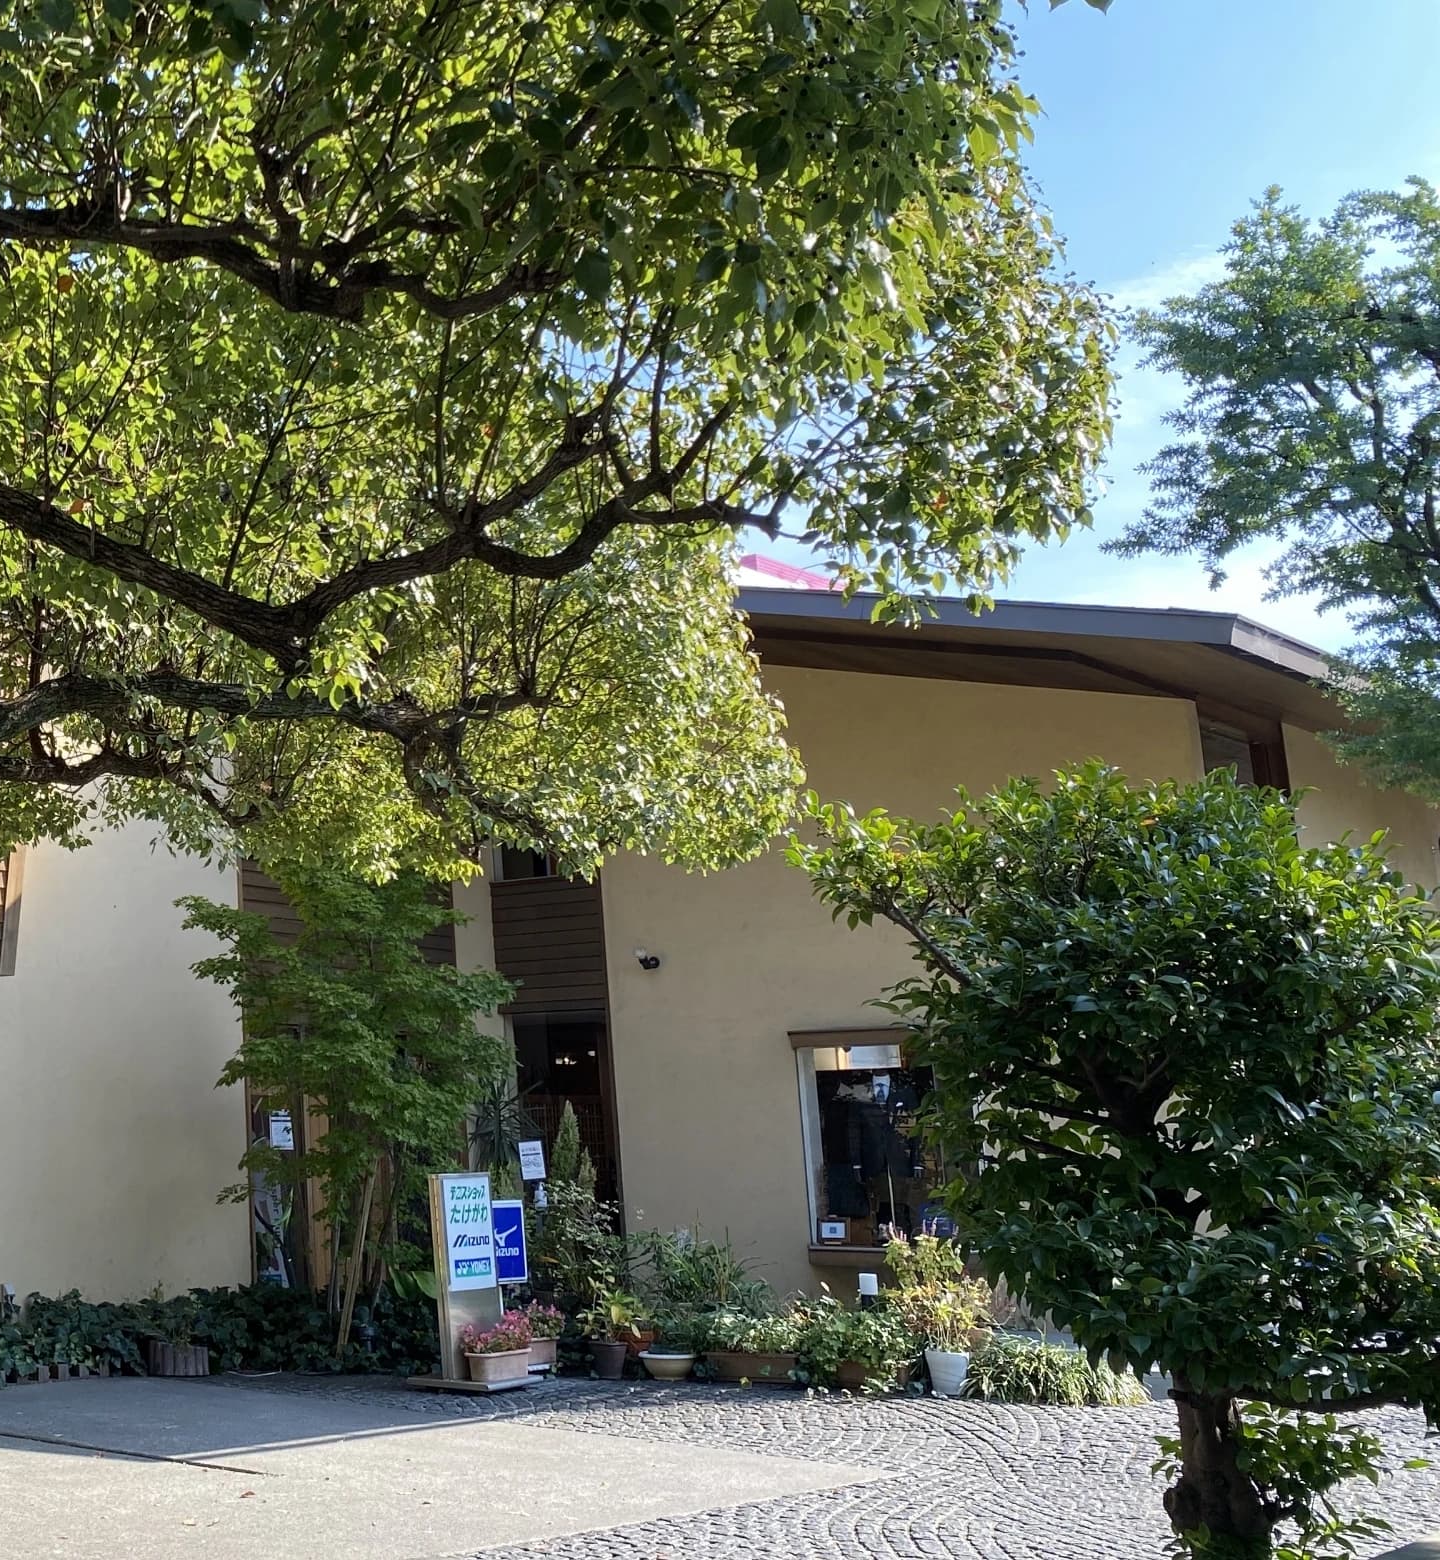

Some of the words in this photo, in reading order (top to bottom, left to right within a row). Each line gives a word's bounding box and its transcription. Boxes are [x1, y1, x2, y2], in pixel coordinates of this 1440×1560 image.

[450, 1185, 485, 1200] テニスショップ
[453, 1234, 490, 1248] MIZUNO
[470, 1258, 490, 1273] YONEX
